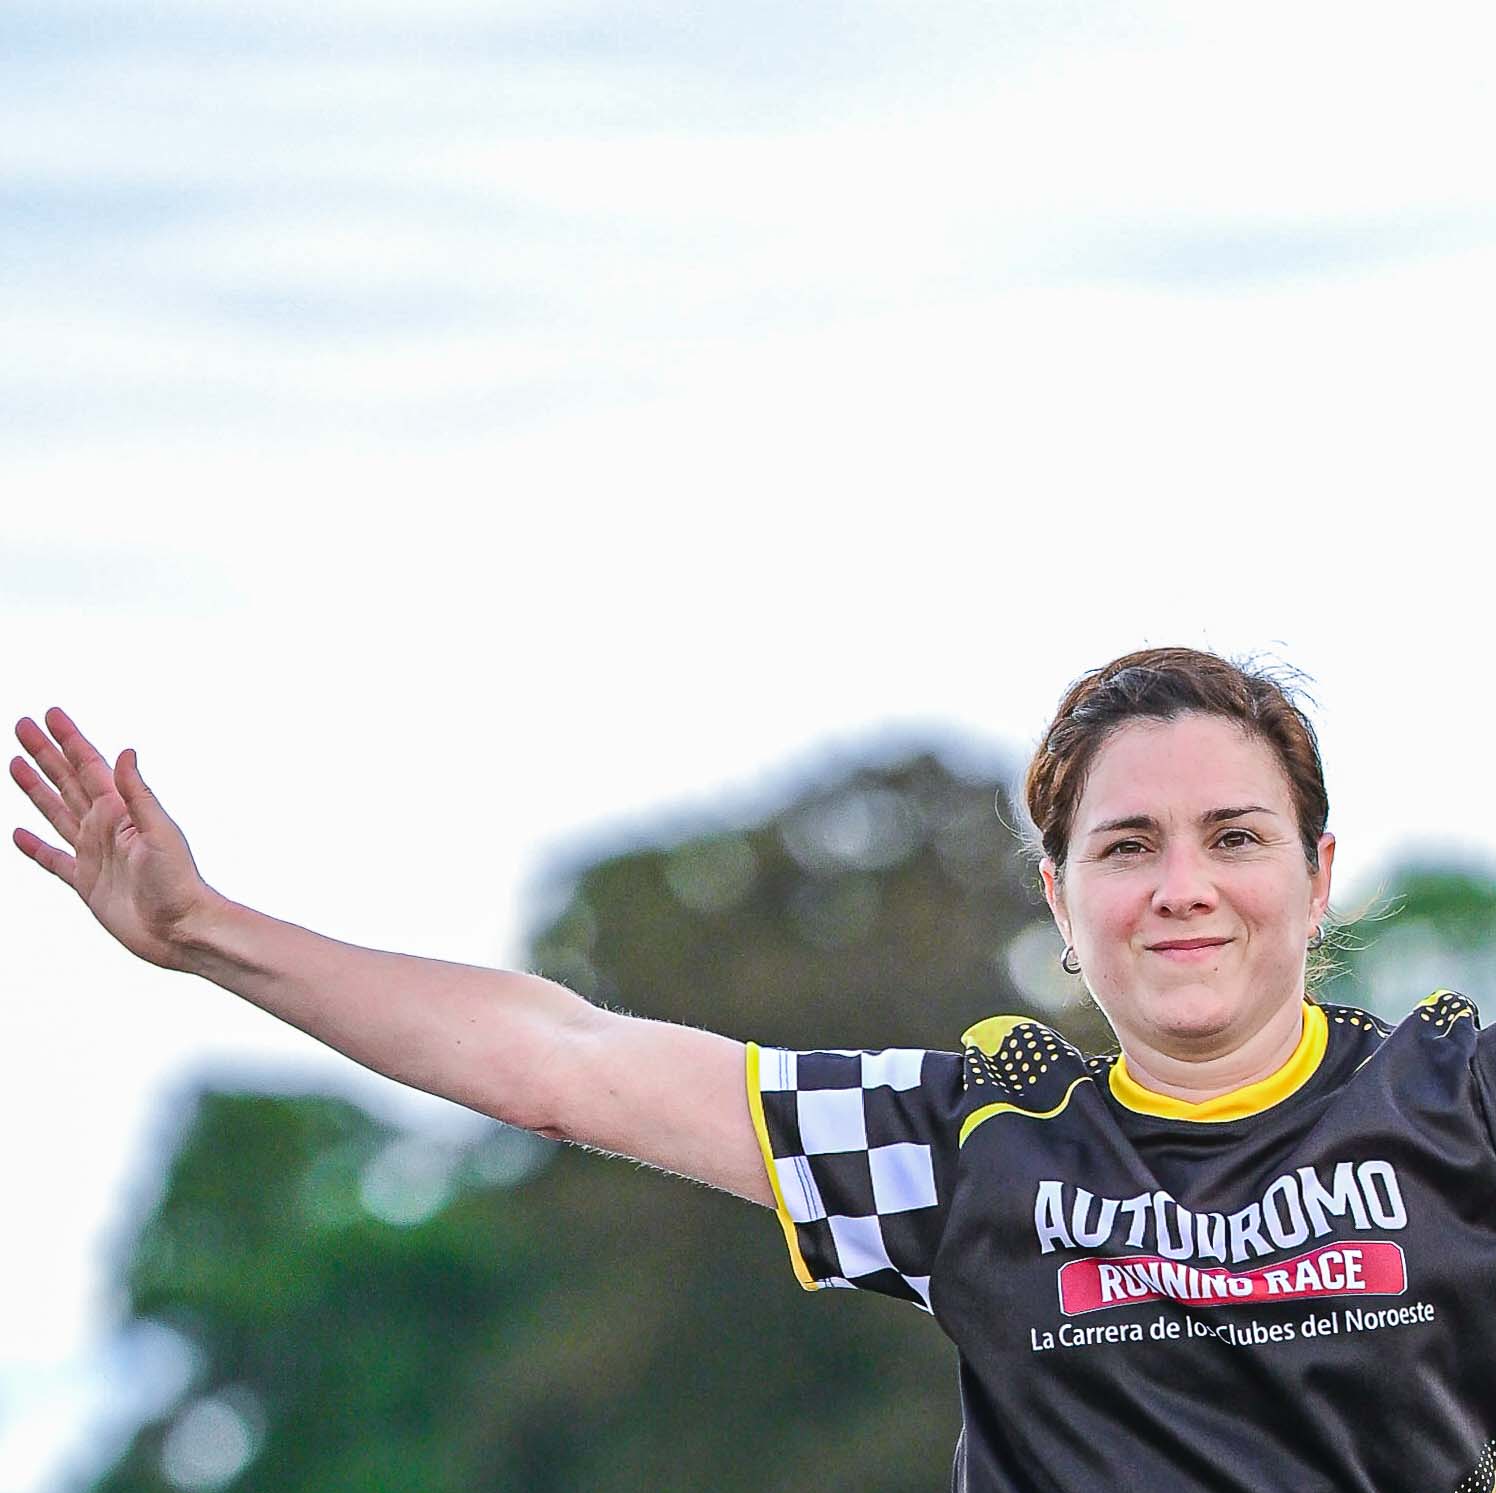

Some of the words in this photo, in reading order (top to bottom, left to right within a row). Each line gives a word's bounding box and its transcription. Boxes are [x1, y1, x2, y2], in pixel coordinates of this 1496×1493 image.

[1263, 1249, 1364, 1294] RACE
[1031, 1327, 1053, 1350] La
[1058, 1323, 1142, 1346] Carrera
[1150, 1316, 1179, 1340] de
[1186, 1315, 1215, 1337] los
[1215, 1320, 1294, 1346] Clubes
[1301, 1312, 1338, 1338] del
[1345, 1302, 1433, 1332] Noroeste
